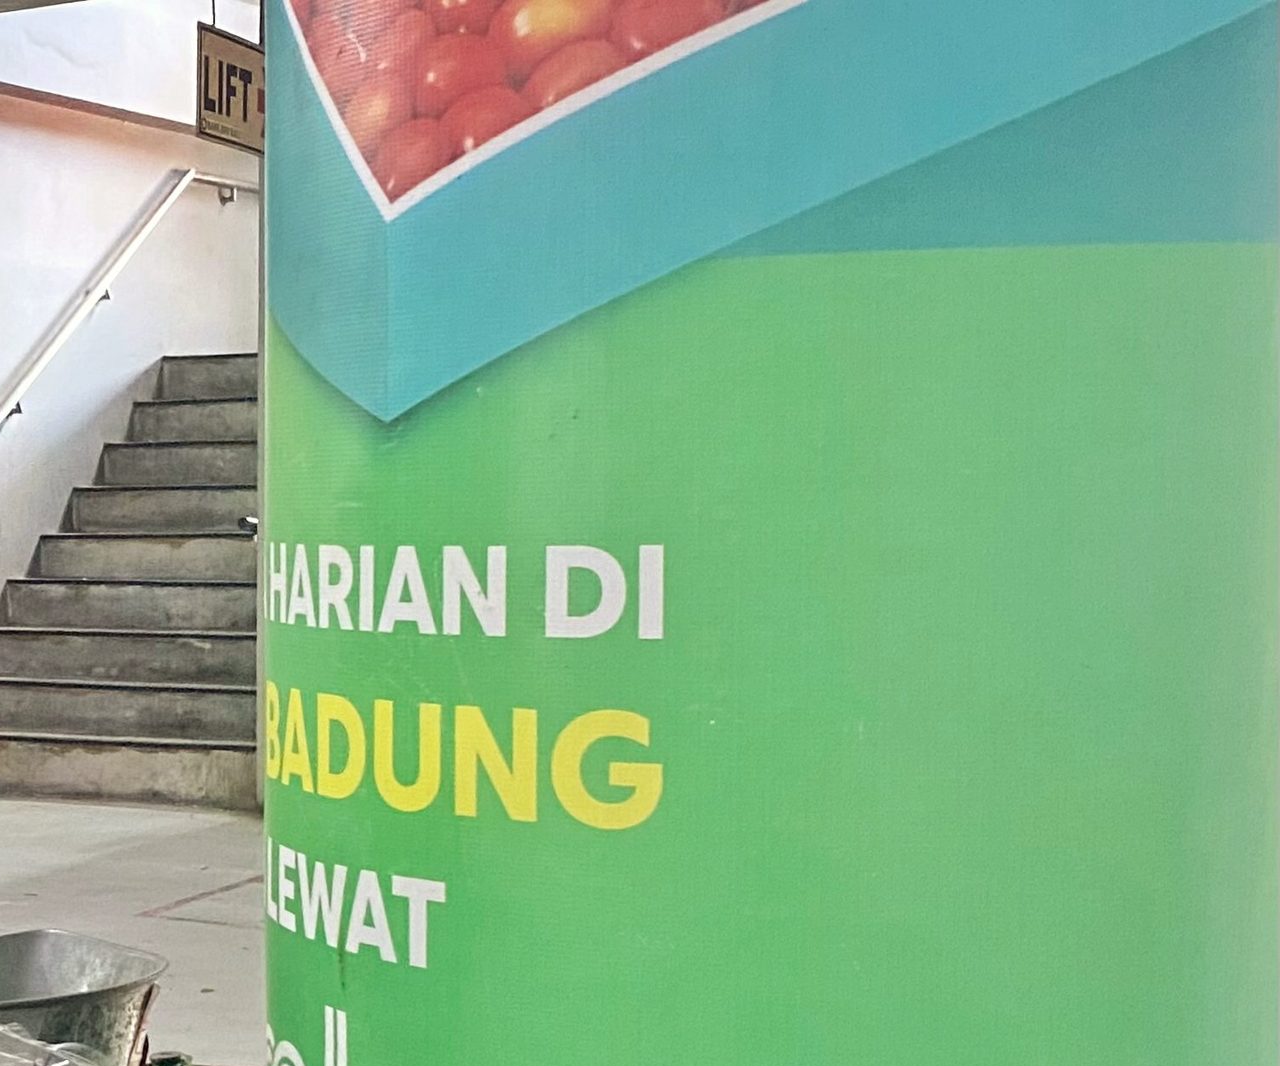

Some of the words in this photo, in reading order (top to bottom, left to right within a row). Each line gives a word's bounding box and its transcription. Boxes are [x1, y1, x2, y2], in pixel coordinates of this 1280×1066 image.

[203, 54, 253, 123] LIFT
[269, 541, 507, 637] HARIAN
[544, 543, 664, 640] DI
[266, 679, 664, 831] BADUNG
[267, 836, 446, 969] LEWAT
